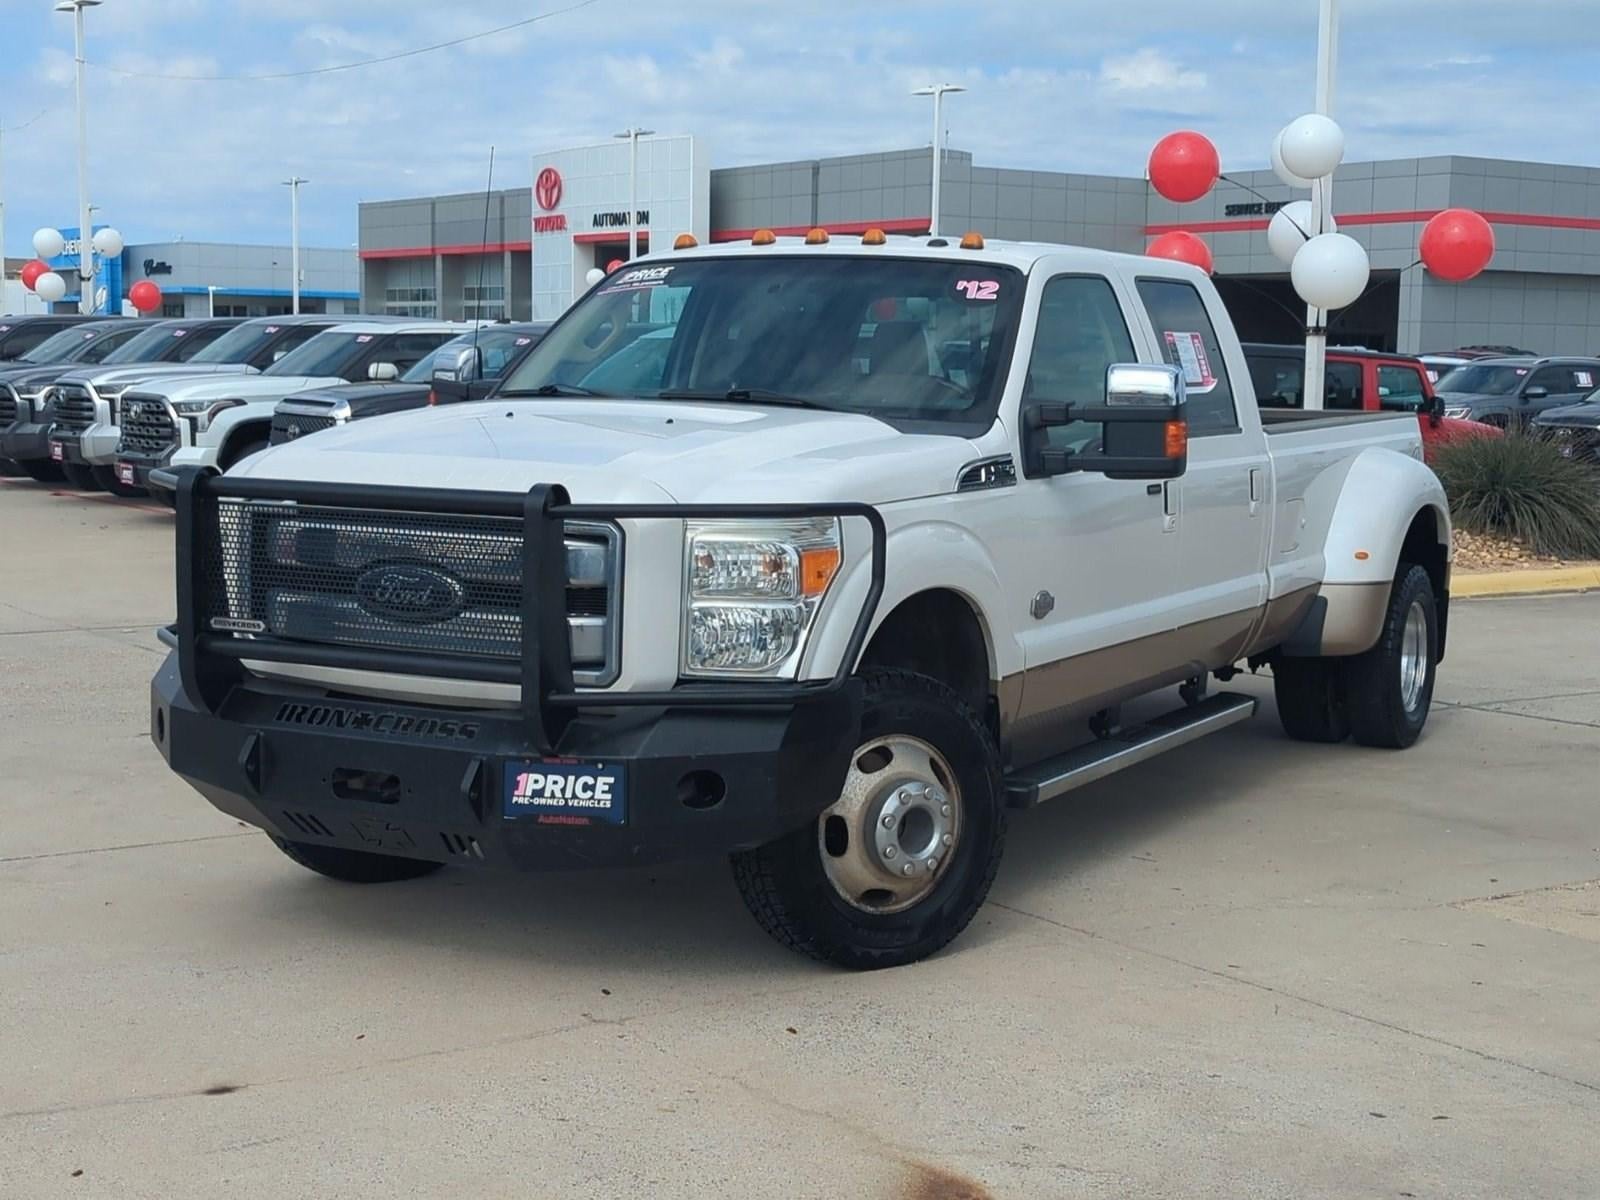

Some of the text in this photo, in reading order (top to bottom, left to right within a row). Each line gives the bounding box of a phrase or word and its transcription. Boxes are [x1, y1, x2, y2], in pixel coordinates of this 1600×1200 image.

[533, 214, 567, 232] TOYOTA
[593, 211, 649, 227] AUTONATON
[376, 574, 433, 604] Ford
[371, 713, 480, 739] CROSS
[512, 796, 611, 808] PRE-OWNED VEHICLES
